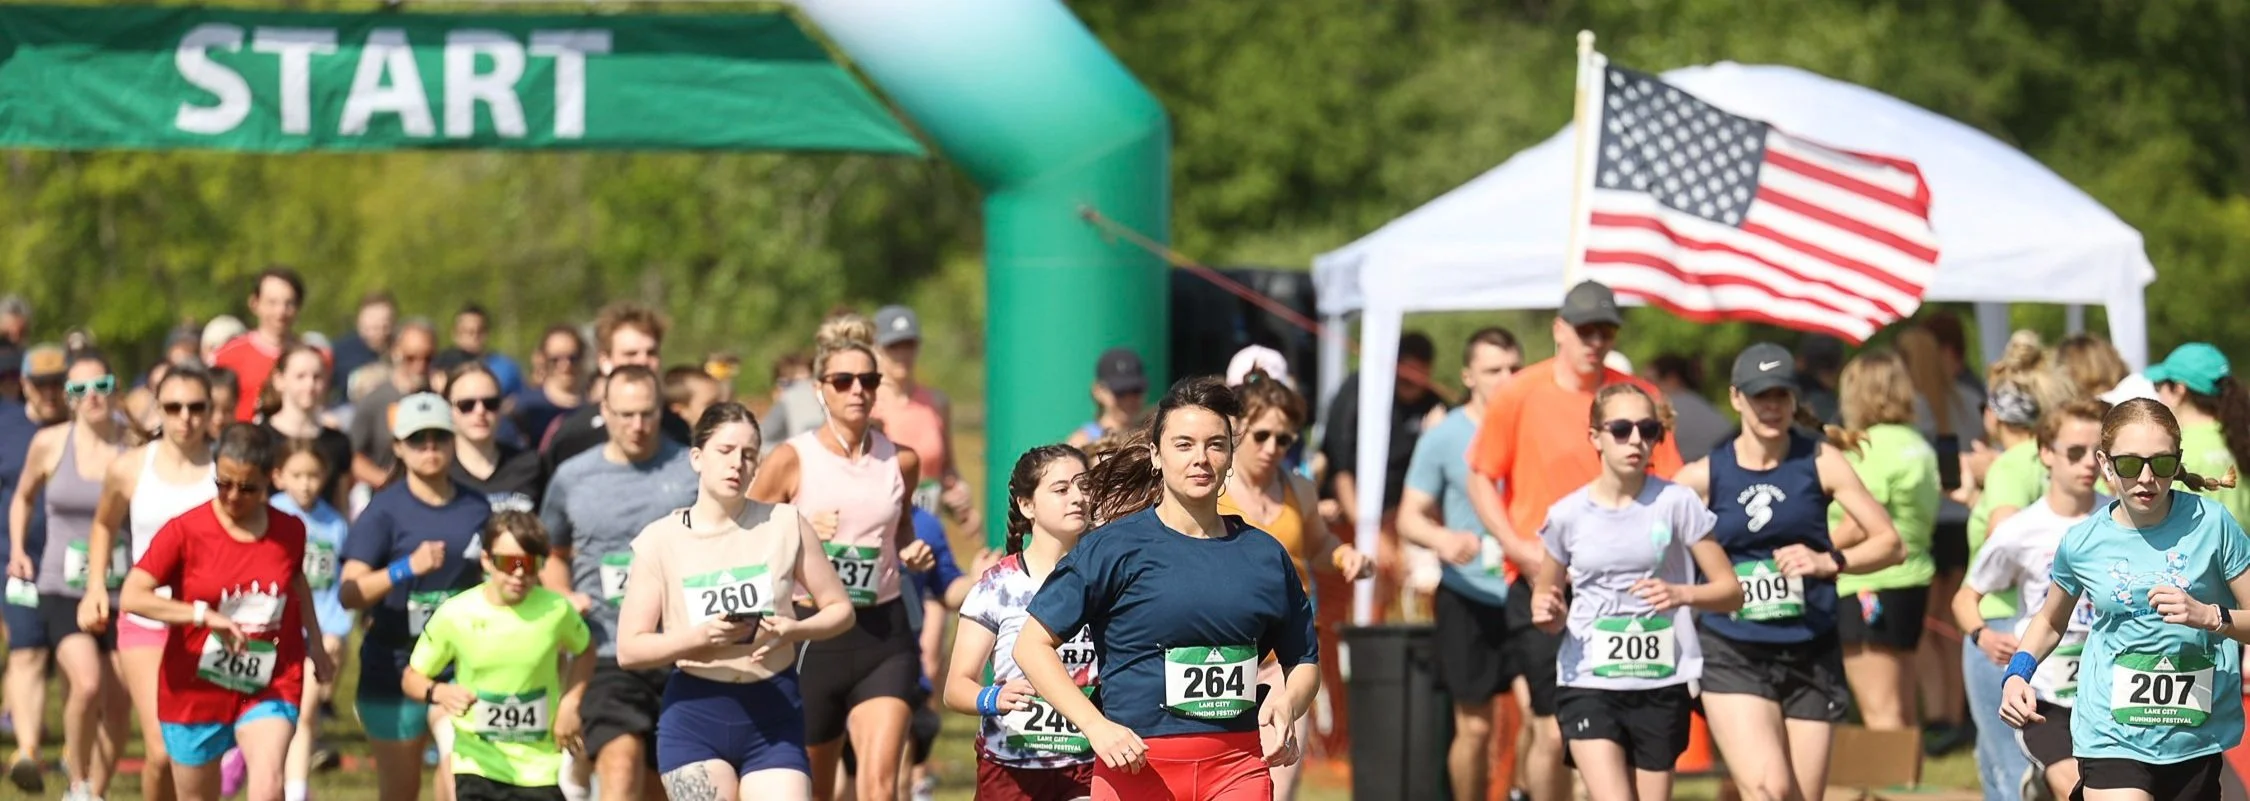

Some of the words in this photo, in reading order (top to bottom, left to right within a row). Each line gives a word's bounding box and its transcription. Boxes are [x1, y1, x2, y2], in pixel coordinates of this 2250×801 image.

[175, 22, 613, 138] START
[831, 560, 874, 587] 37
[701, 583, 758, 616] 260
[1608, 635, 1659, 660] 208
[213, 648, 260, 678] 268
[1184, 666, 1244, 698] 264
[2129, 673, 2195, 705] 207
[488, 706, 536, 727] 294
[1053, 743, 1082, 752] FESTIVAL
